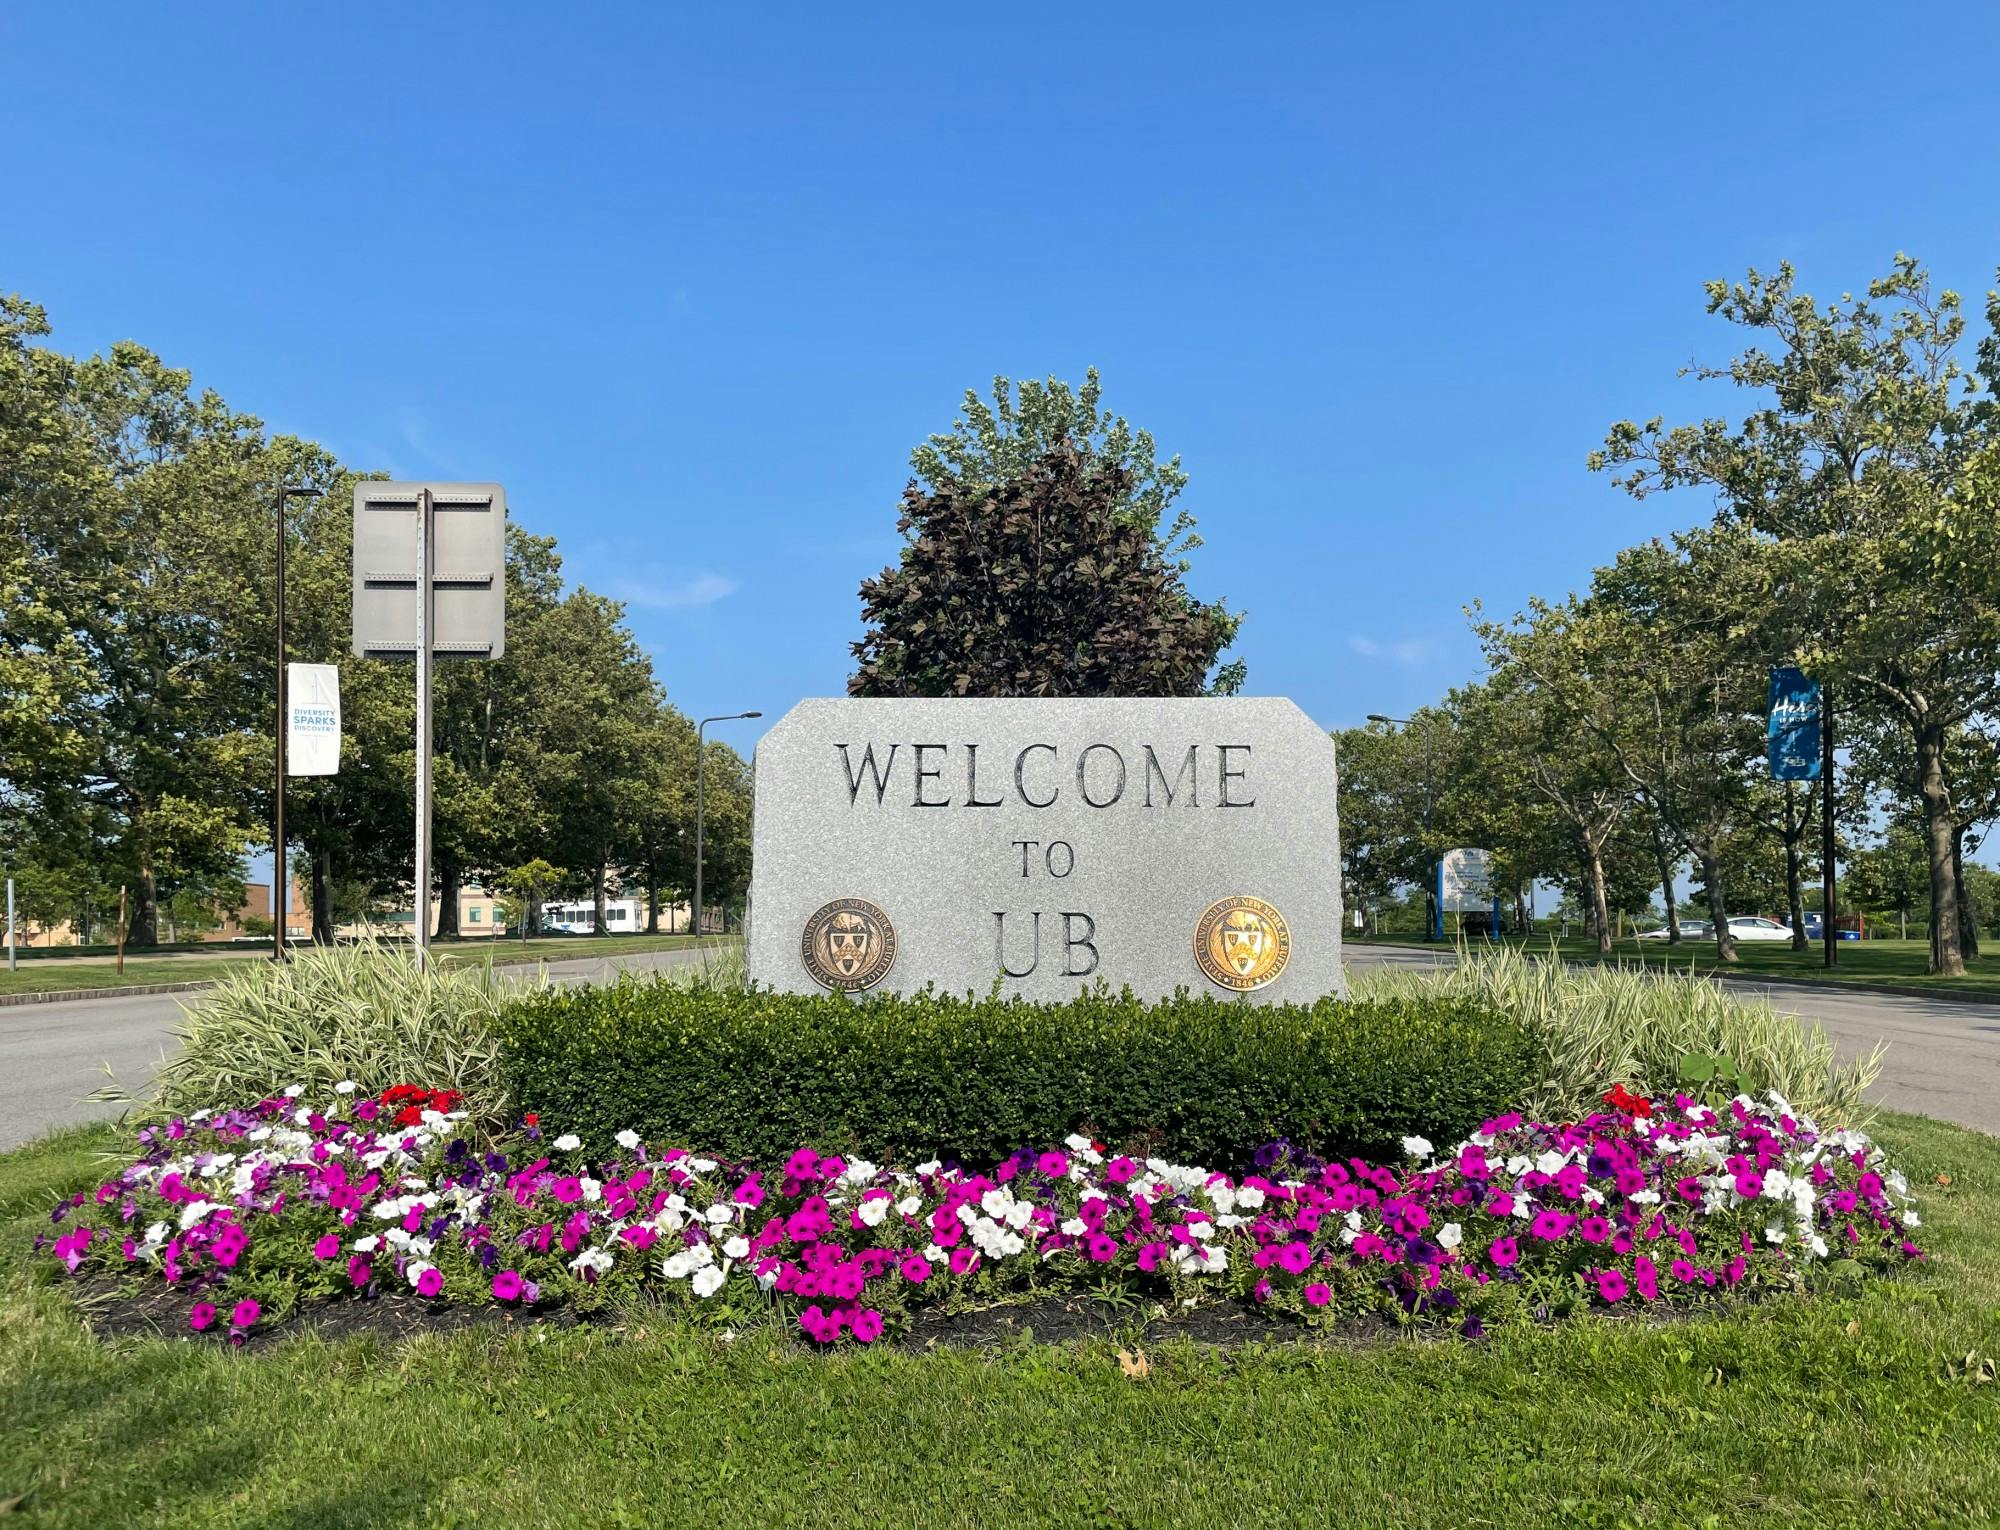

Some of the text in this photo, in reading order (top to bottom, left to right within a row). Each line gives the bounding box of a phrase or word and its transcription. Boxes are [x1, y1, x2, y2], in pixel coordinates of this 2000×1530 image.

[293, 715, 336, 725] SPARKS
[294, 708, 335, 716] DIVERSITY
[833, 742, 1257, 809] WELCOME
[1012, 840, 1075, 878] TO
[831, 901, 846, 911] OF
[848, 900, 868, 910] NEW
[871, 906, 891, 931] YORK
[803, 907, 831, 957] UNIVERSITY
[885, 931, 894, 946] AT
[1197, 898, 1289, 981] STATE UNIVERSITY OF NEW YORK AT BUFFALO
[992, 911, 1100, 979] UB
[867, 947, 895, 983] BUFFALO
[1231, 979, 1254, 988] 1846
